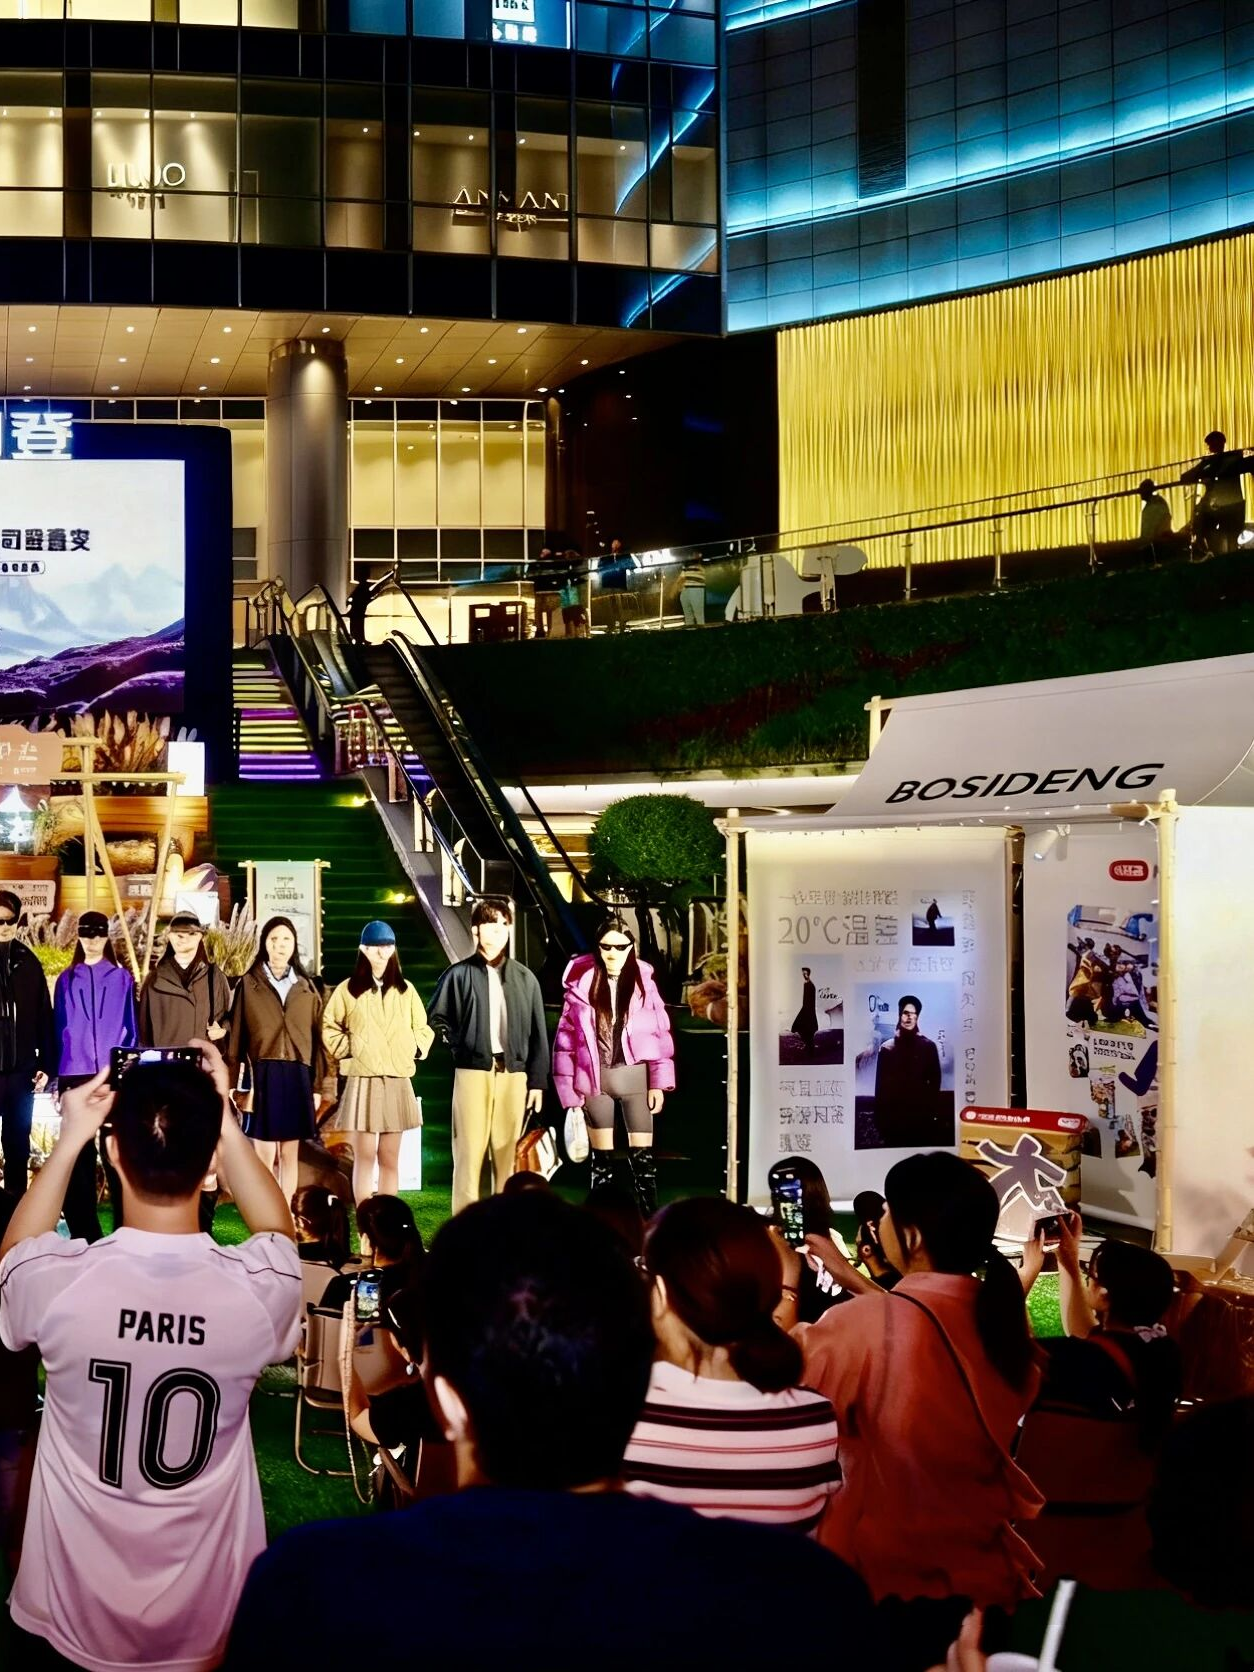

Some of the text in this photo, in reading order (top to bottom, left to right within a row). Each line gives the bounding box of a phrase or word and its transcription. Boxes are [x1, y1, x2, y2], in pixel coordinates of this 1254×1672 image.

[885, 763, 1165, 803] BOSIDENG
[117, 1308, 206, 1346] PARIS
[88, 1358, 221, 1490] 10
